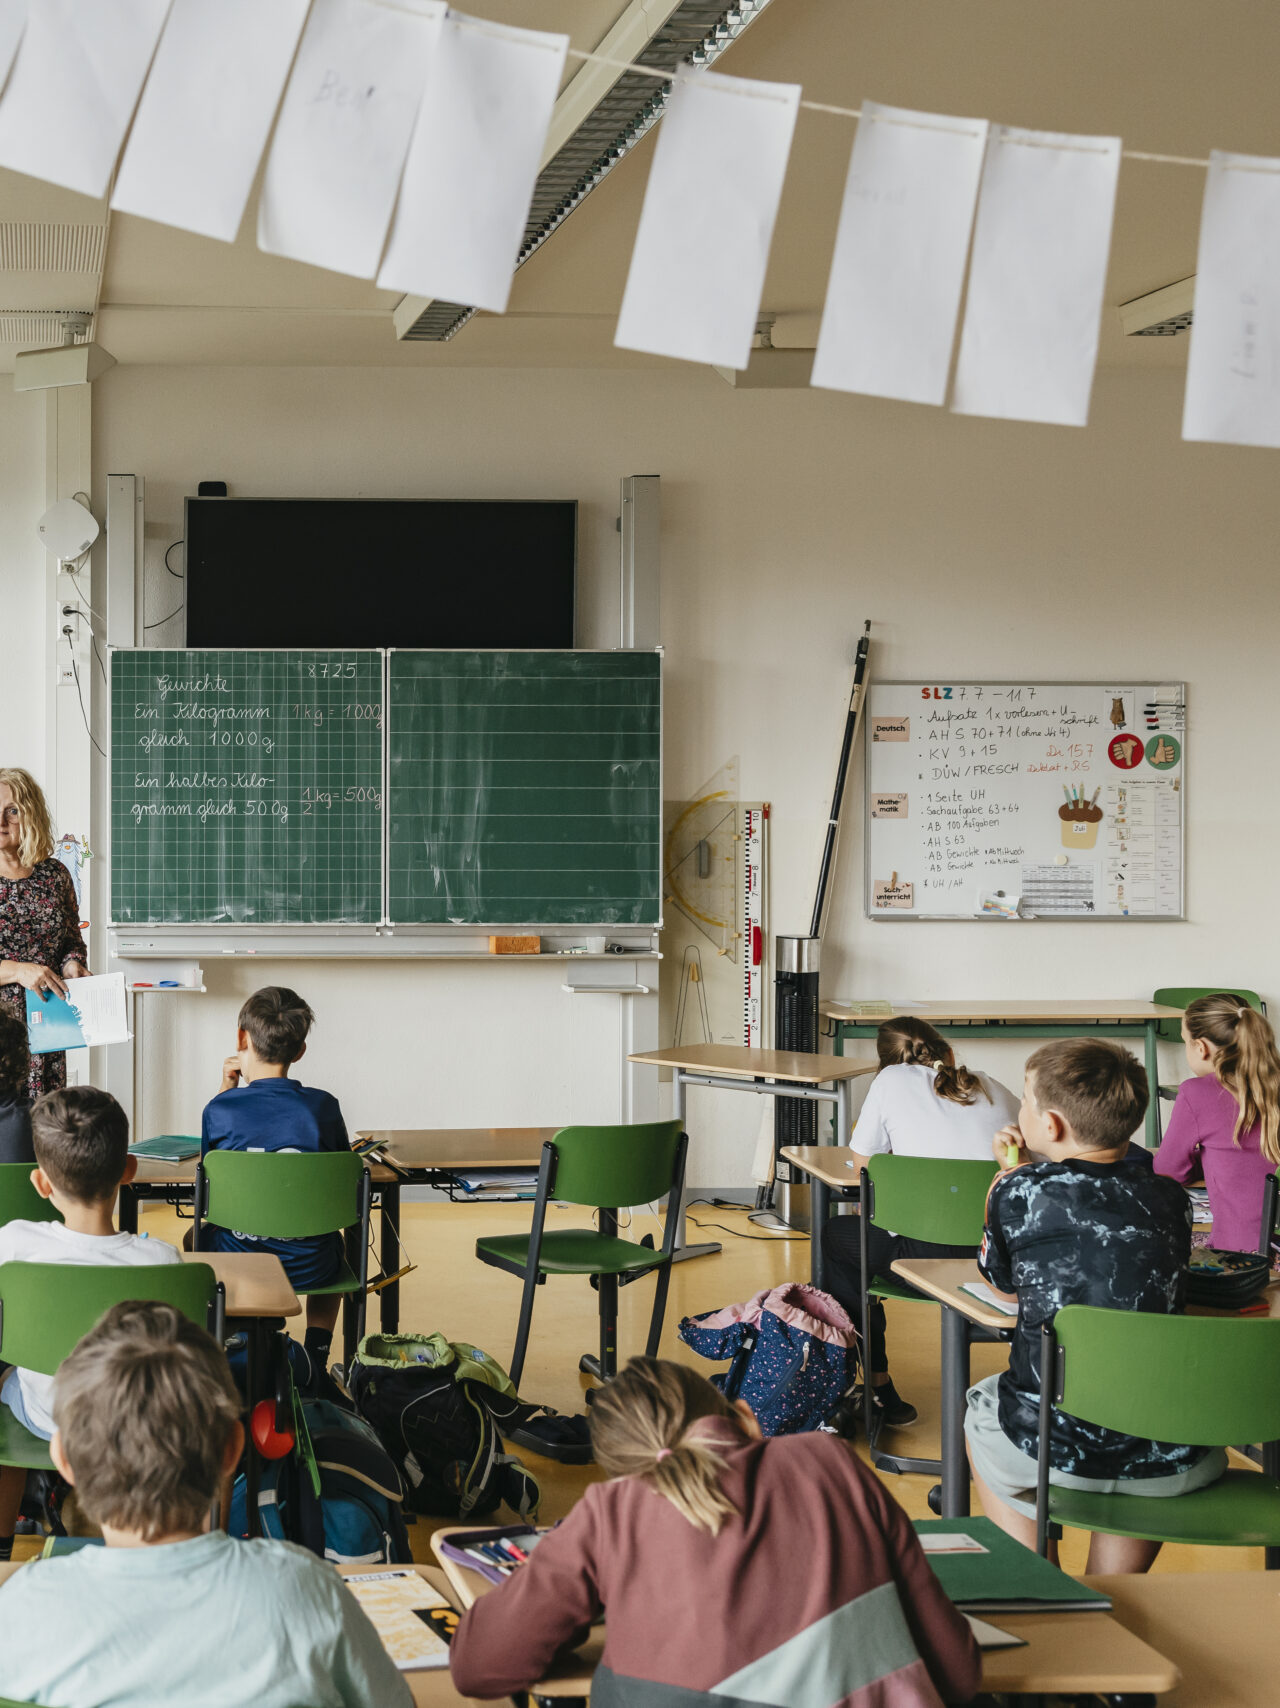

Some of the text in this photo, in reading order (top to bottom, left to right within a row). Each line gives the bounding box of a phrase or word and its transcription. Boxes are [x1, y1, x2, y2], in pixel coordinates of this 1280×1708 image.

[157, 674, 232, 700] Gewichte
[922, 688, 952, 700] SLZ
[134, 702, 270, 728] Ein Kilogramm
[1005, 707, 1049, 720] vorlesen
[138, 729, 189, 753] gleich
[929, 748, 949, 760] KV
[980, 744, 998, 756] 15
[973, 763, 1018, 775] FRESCH
[134, 772, 276, 788] Ein halbes Kilo-
[936, 790, 962, 802] Seite
[970, 789, 985, 800] UH
[130, 804, 192, 824] gramm
[196, 799, 237, 823] gleich
[927, 805, 983, 819] Sachaufgabe
[927, 818, 1000, 832] AB 100 Aufgaben
[928, 837, 940, 847] AH
[955, 834, 965, 844] 63
[928, 846, 980, 861] AB Gewichte
[930, 861, 973, 872] AB Gewichte
